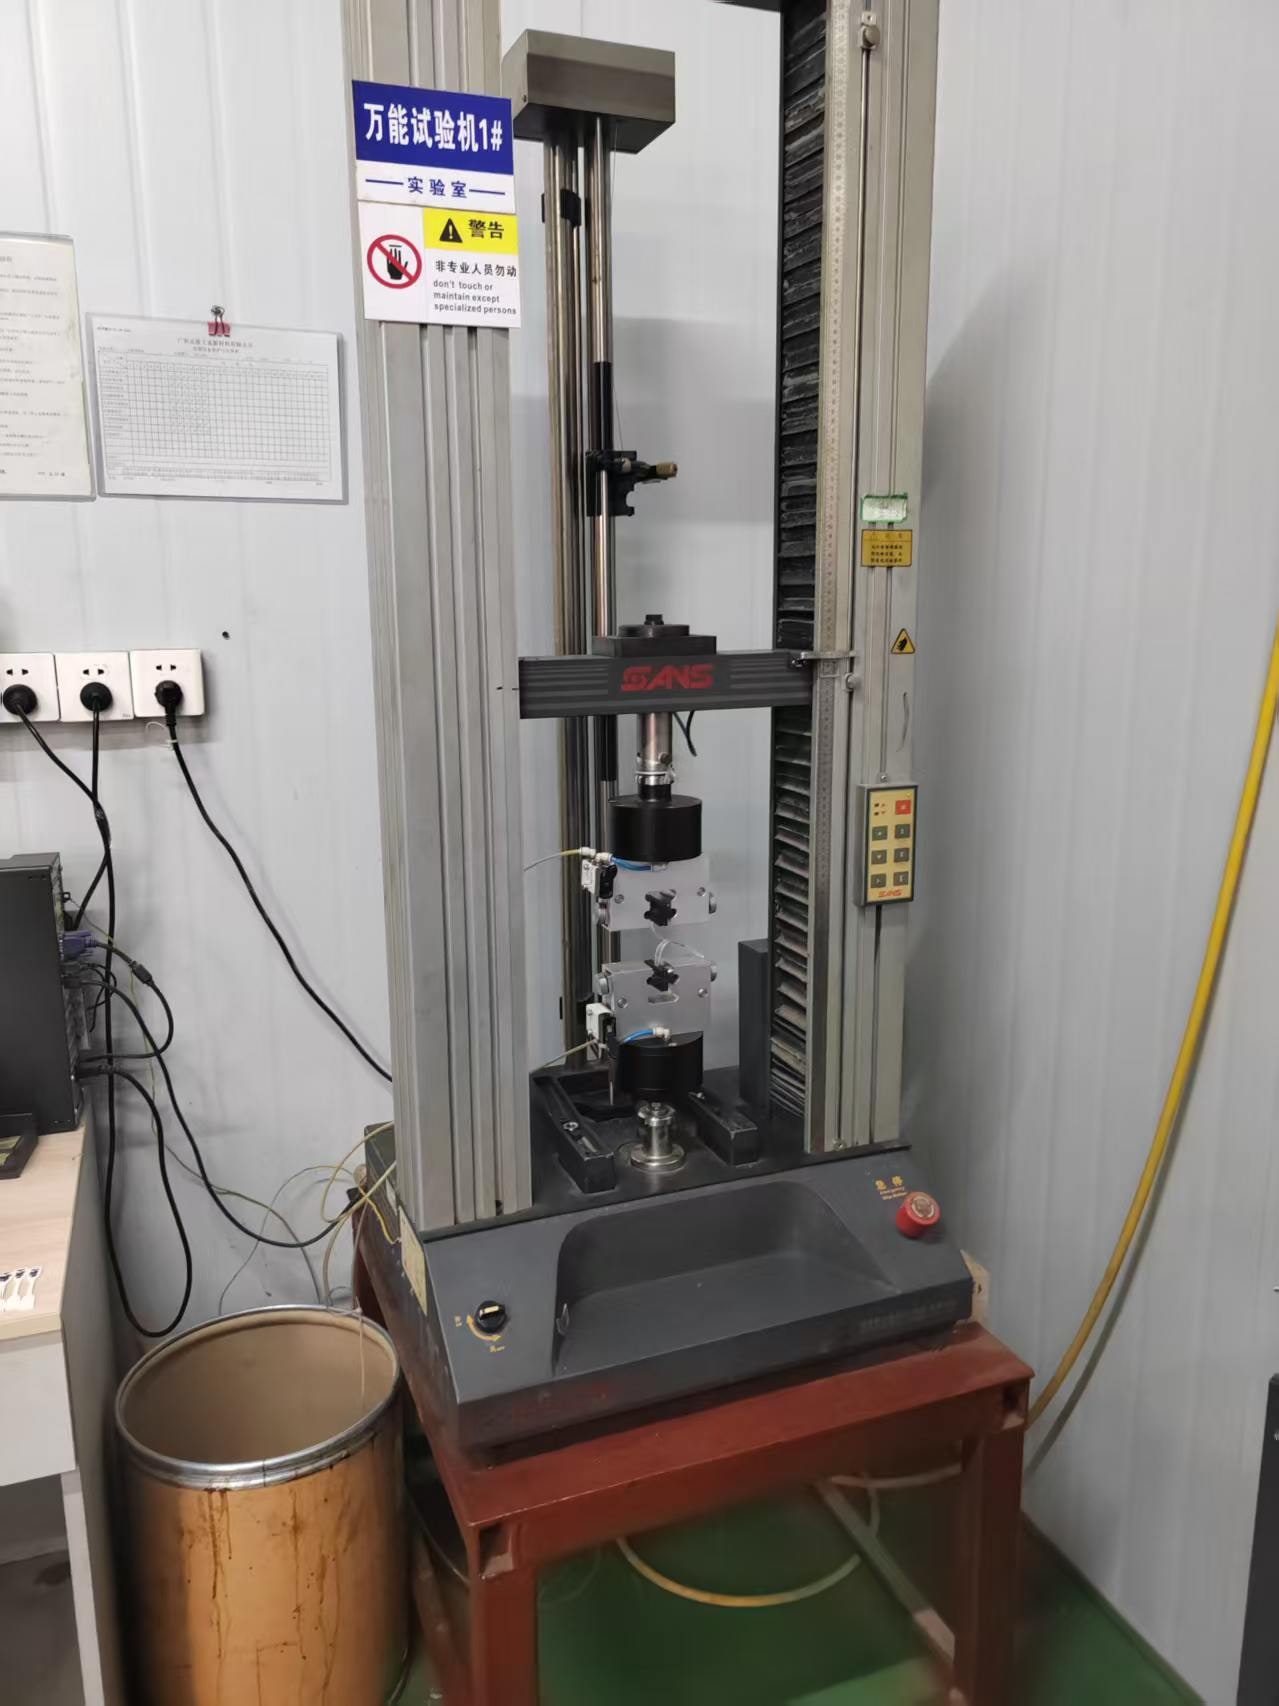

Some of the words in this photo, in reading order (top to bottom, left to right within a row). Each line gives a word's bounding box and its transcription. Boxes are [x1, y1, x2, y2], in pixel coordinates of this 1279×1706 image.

[363, 102, 503, 152] 万能试验机1#
[407, 176, 467, 198] 实验室
[468, 218, 504, 240] 警告
[435, 259, 517, 277] 非专业人员勿动
[433, 280, 455, 289] don't
[458, 281, 482, 290] touch
[433, 292, 470, 301] maintain
[472, 295, 500, 304] except
[434, 303, 482, 313] specialized
[483, 306, 517, 315] persons
[621, 664, 714, 691] SANS
